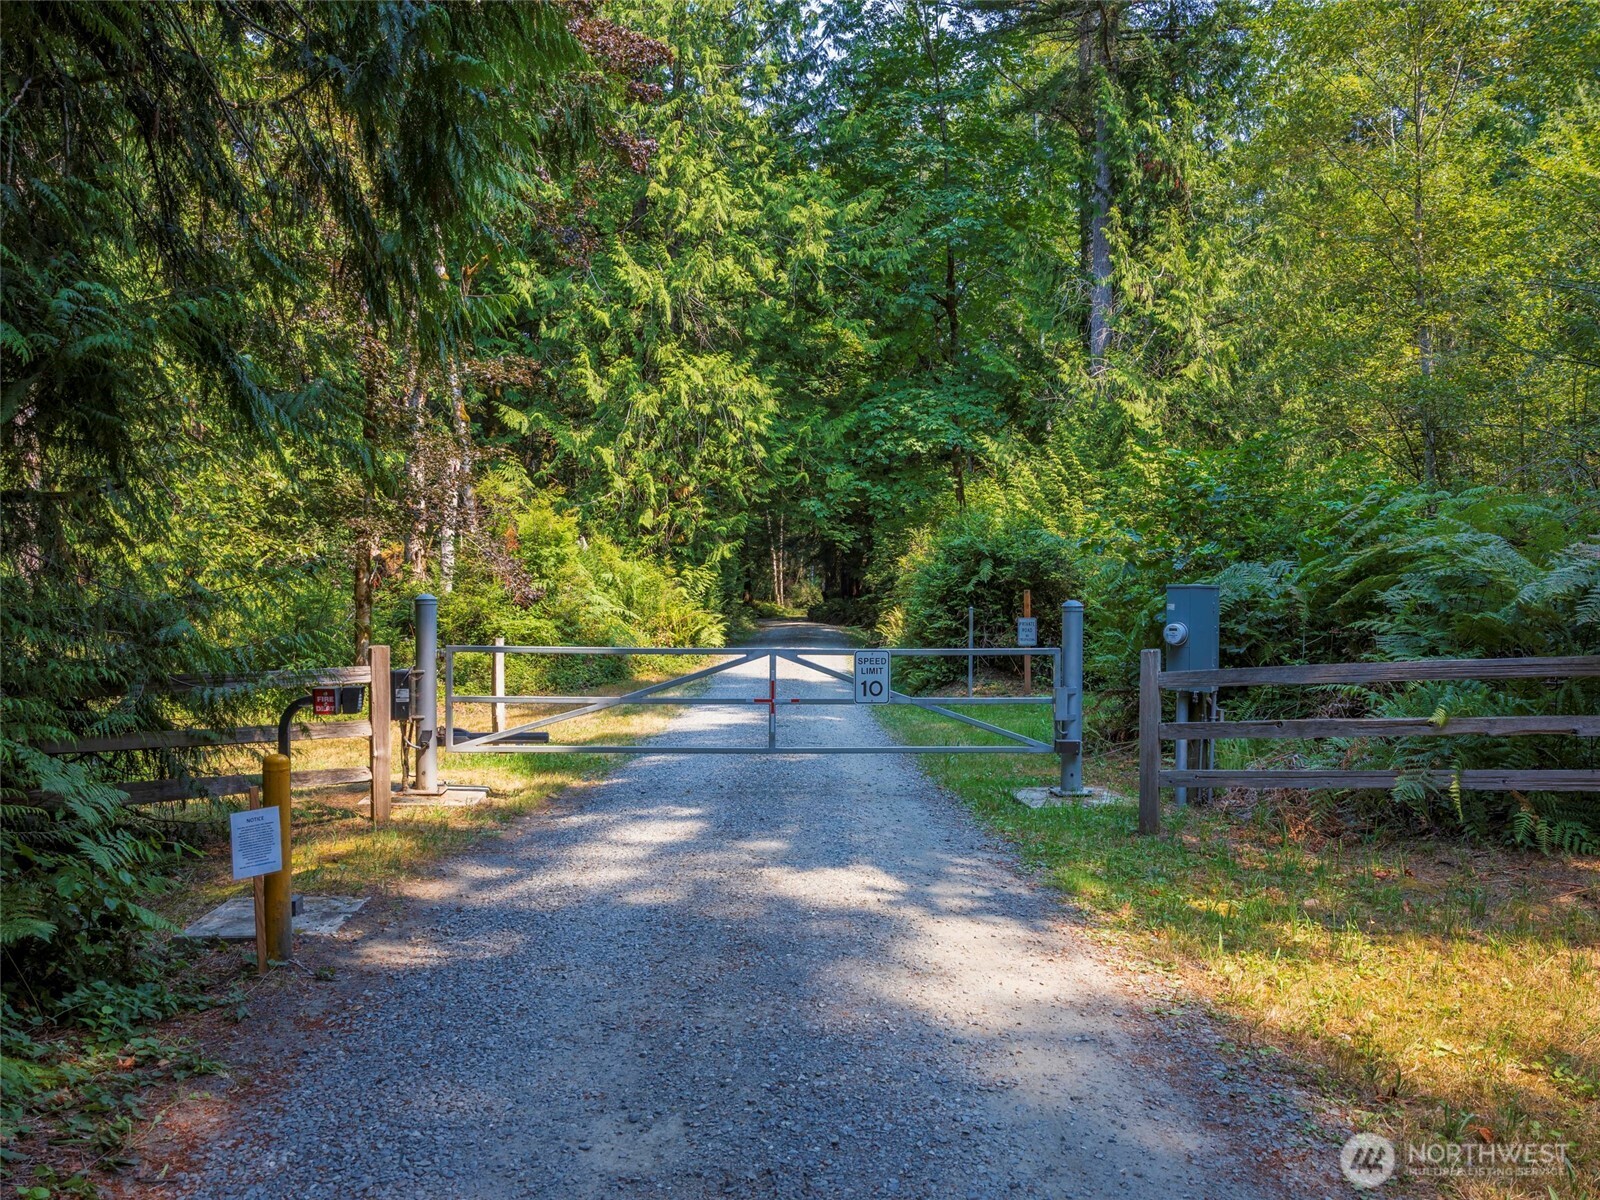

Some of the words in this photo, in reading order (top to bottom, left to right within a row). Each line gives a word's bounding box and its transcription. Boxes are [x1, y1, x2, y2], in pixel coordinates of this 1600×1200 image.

[857, 657, 887, 665] SPEED
[861, 667, 884, 675] LIMIT
[861, 680, 883, 697] 10
